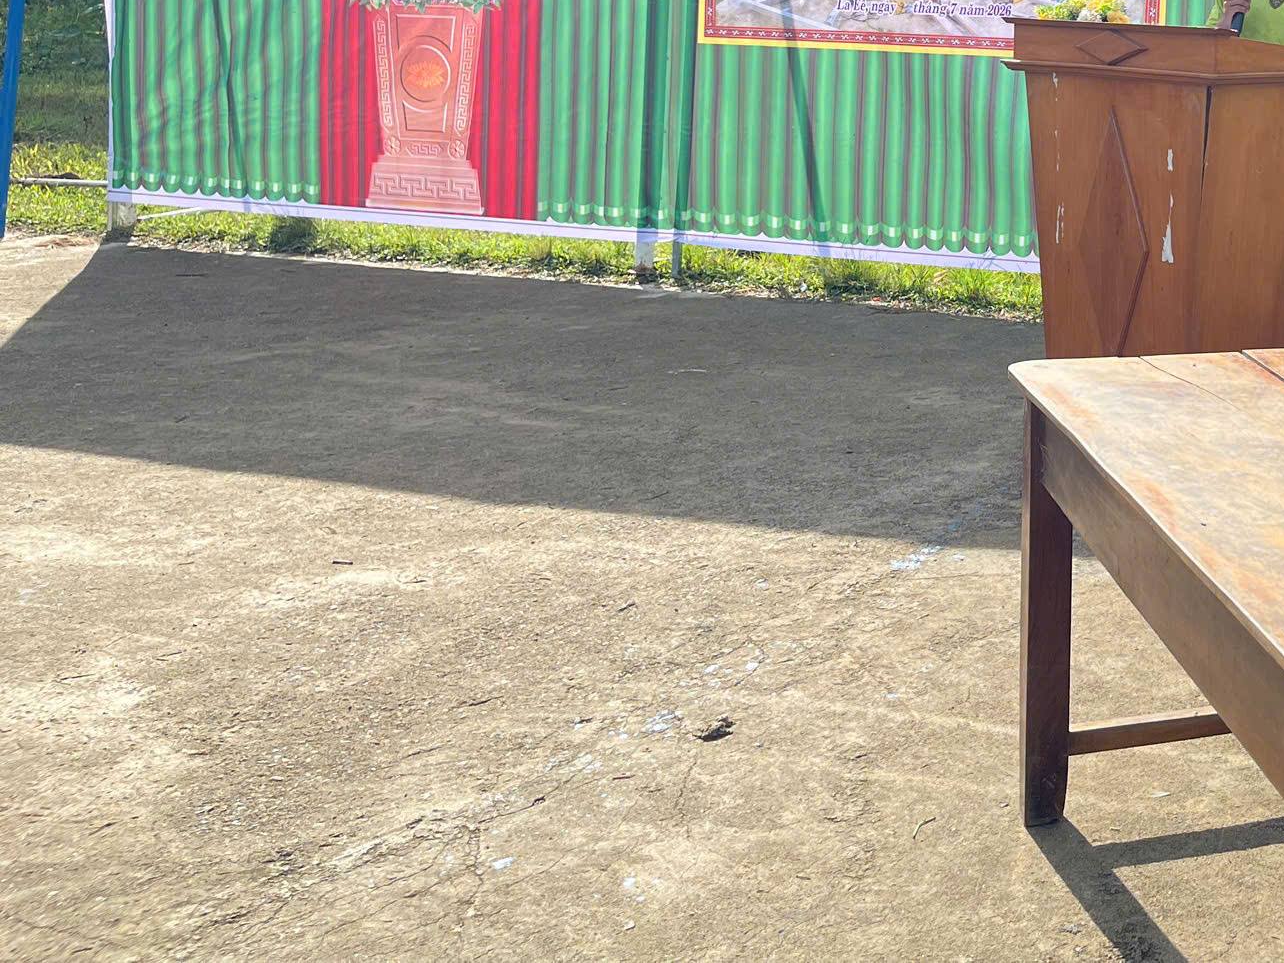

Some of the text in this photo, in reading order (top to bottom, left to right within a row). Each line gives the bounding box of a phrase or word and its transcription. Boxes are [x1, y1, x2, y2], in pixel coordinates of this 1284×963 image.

[872, 0, 897, 16] ngày
[913, 0, 947, 17] tháng
[950, 2, 957, 15] 7
[959, 3, 985, 16] năm
[987, 4, 1012, 17] 2026
